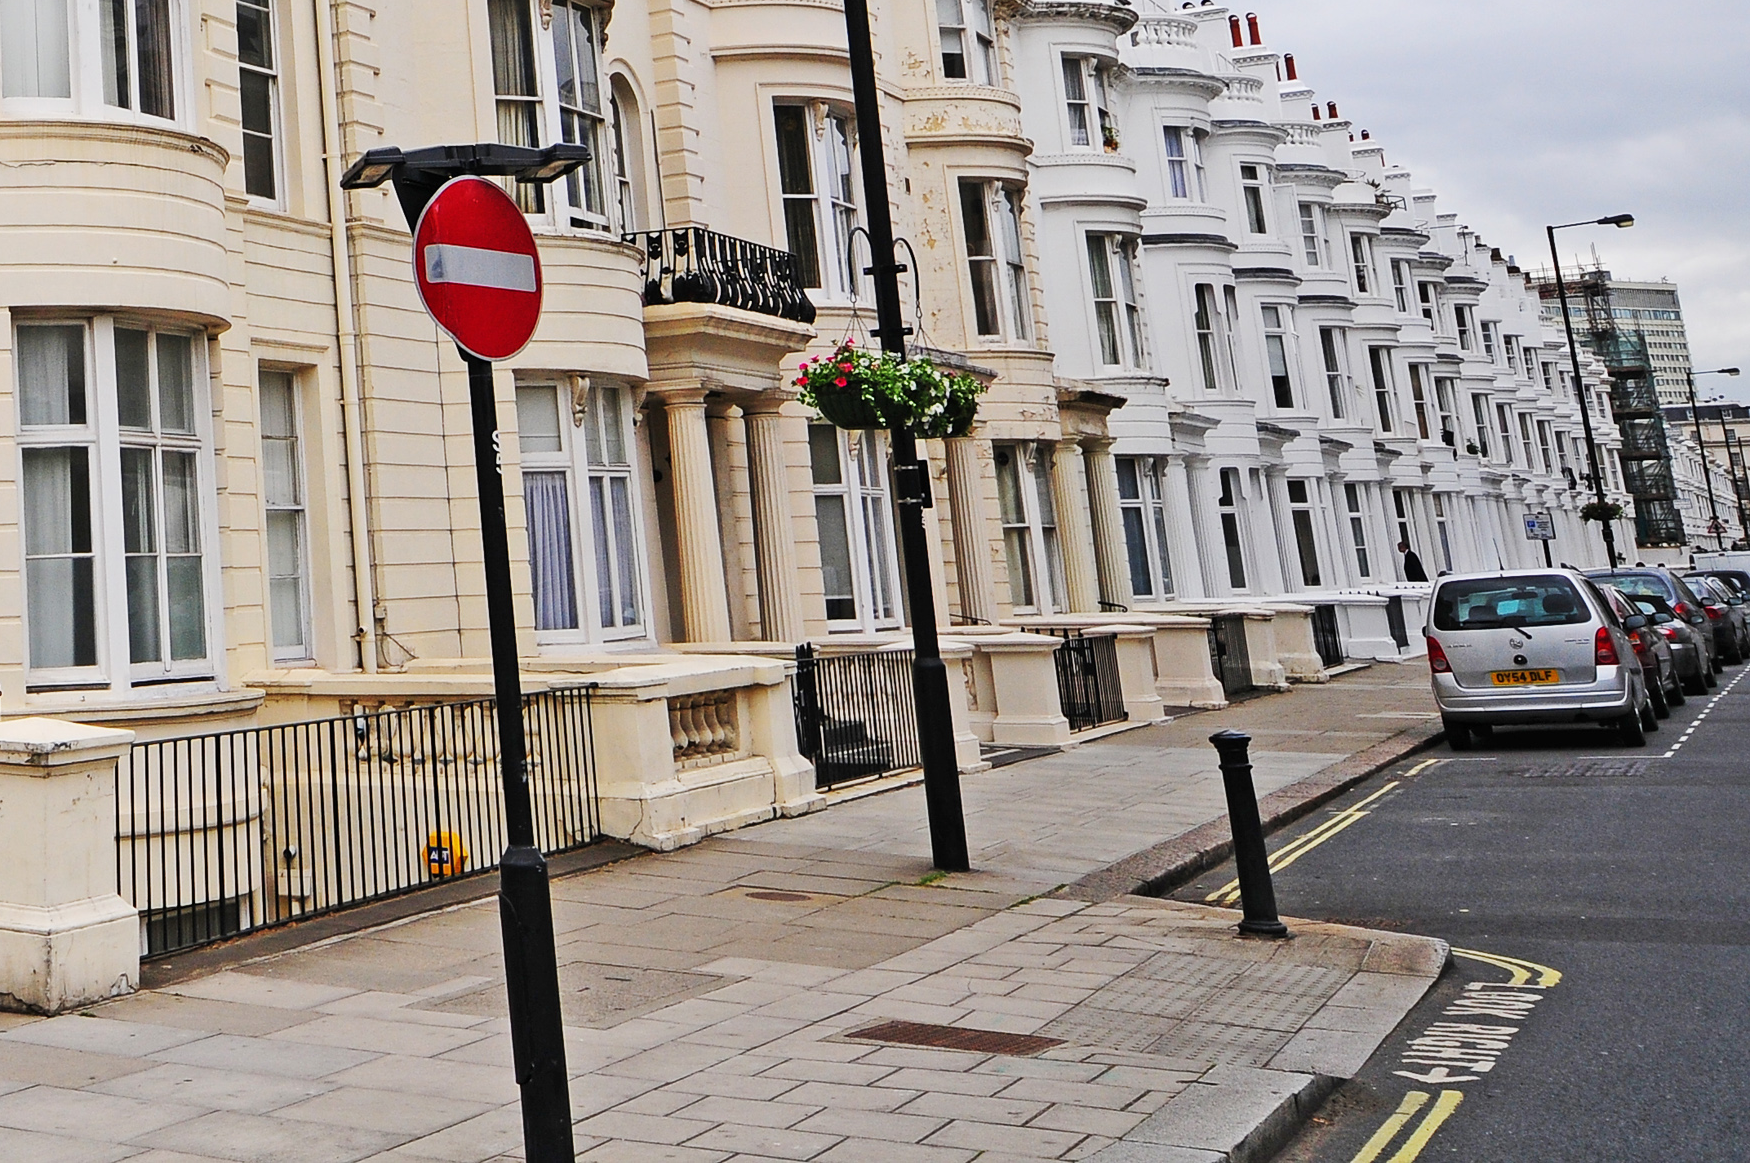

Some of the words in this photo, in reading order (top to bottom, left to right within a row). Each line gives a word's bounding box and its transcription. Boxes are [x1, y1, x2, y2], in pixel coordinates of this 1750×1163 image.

[1496, 672, 1527, 683] OY54
[1529, 670, 1552, 681] DLF
[1441, 981, 1547, 1020] LOOK
[1401, 1022, 1520, 1073] RIGHT
